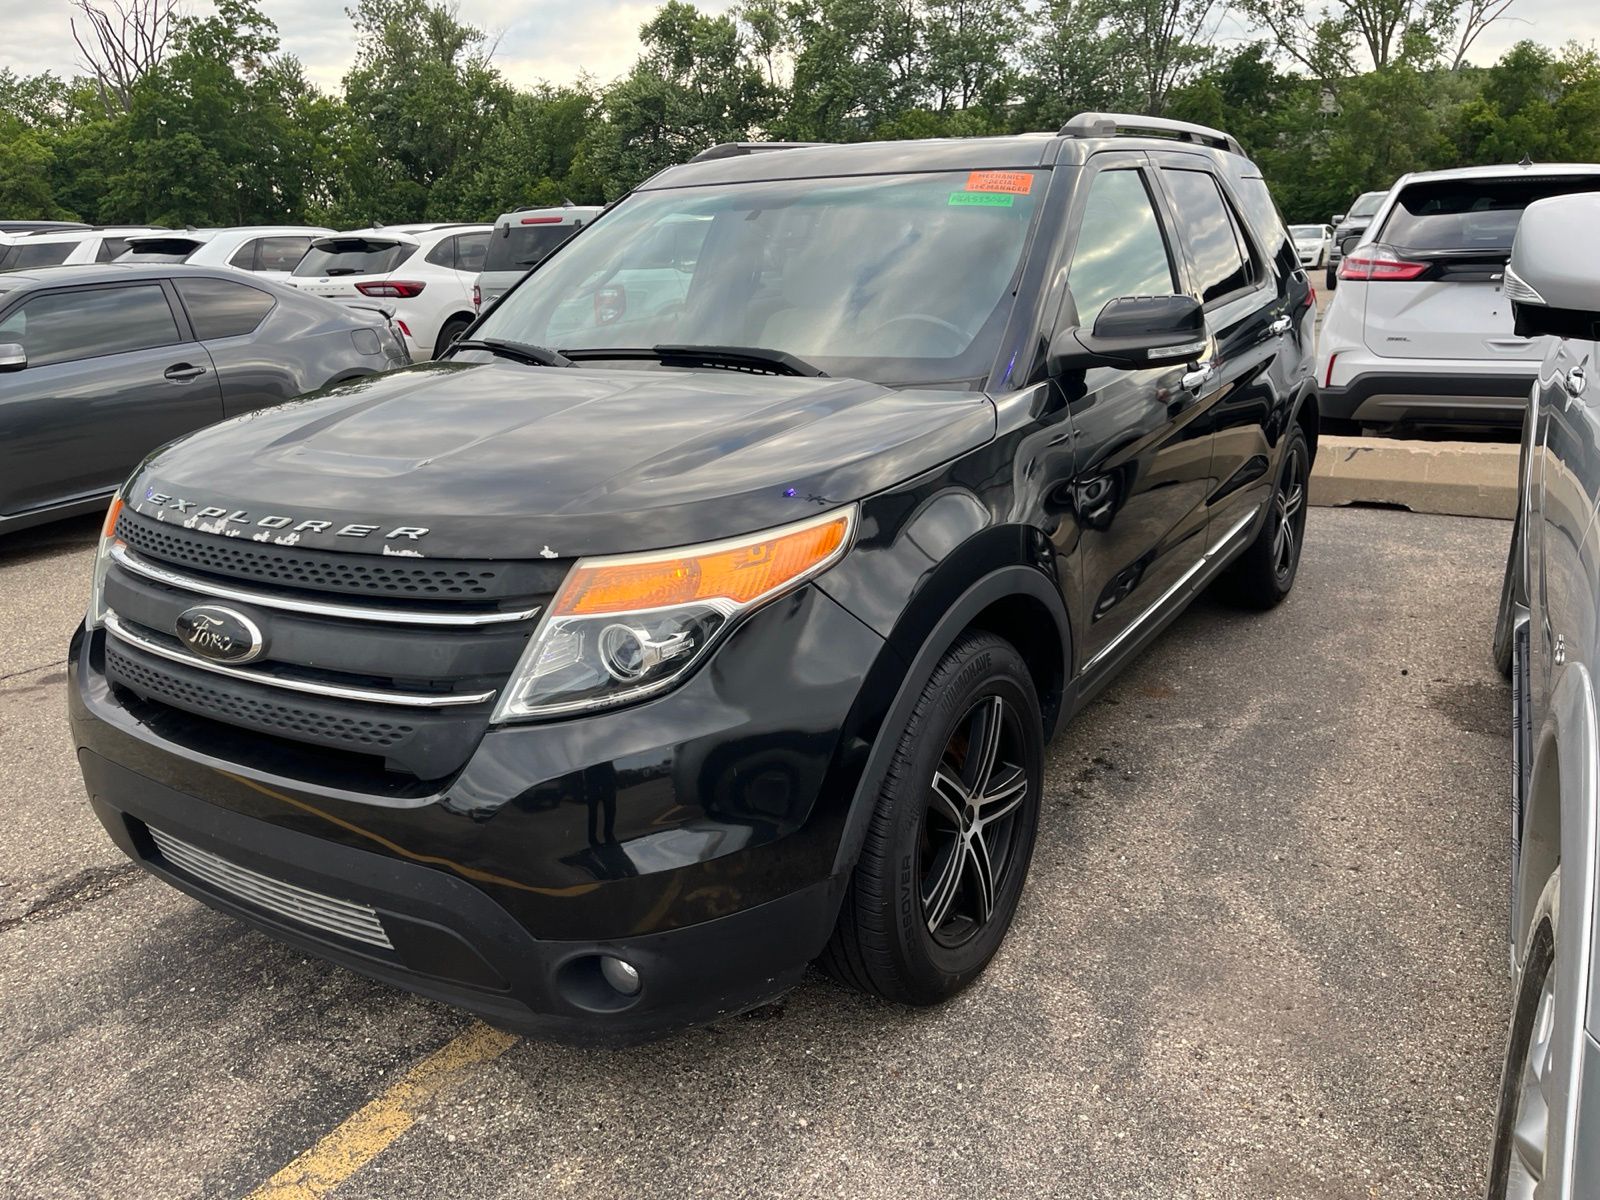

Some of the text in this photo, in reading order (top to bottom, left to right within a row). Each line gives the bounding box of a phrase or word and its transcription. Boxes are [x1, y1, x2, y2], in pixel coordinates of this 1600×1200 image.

[978, 173, 1025, 181] MECHANICS
[987, 184, 1029, 192] MANAGER
[147, 493, 430, 540] EXPLORER
[189, 614, 233, 651] Ford
